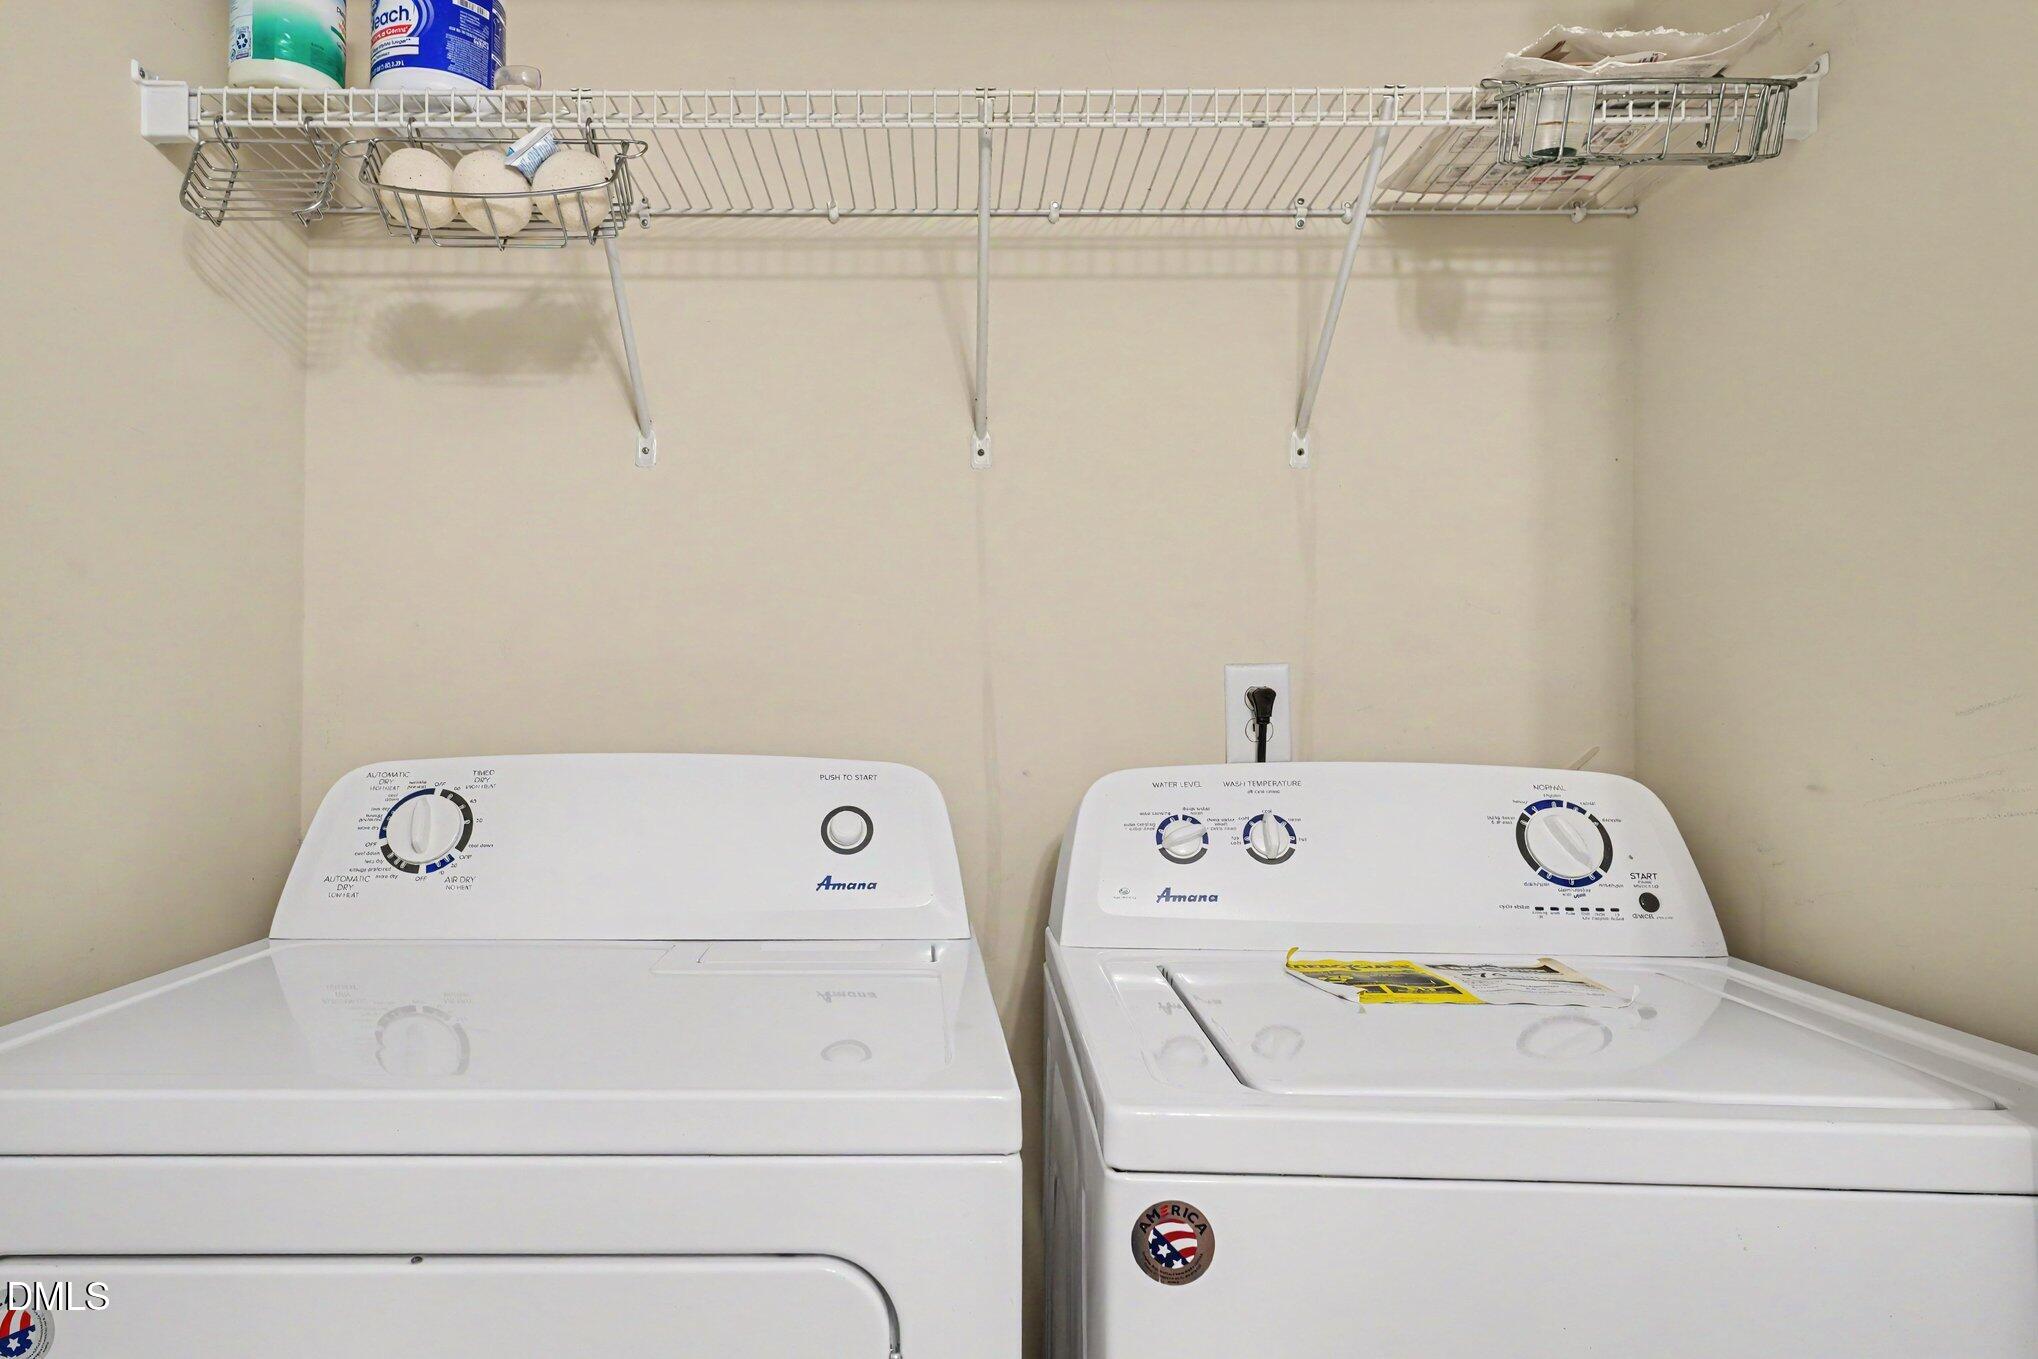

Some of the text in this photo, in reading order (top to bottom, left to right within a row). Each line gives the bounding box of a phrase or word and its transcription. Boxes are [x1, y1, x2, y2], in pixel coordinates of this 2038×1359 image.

[816, 875, 877, 891] Amana
[1629, 872, 1657, 880] START
[1156, 887, 1218, 903] Amana
[1139, 1204, 1207, 1236] AMERICA
